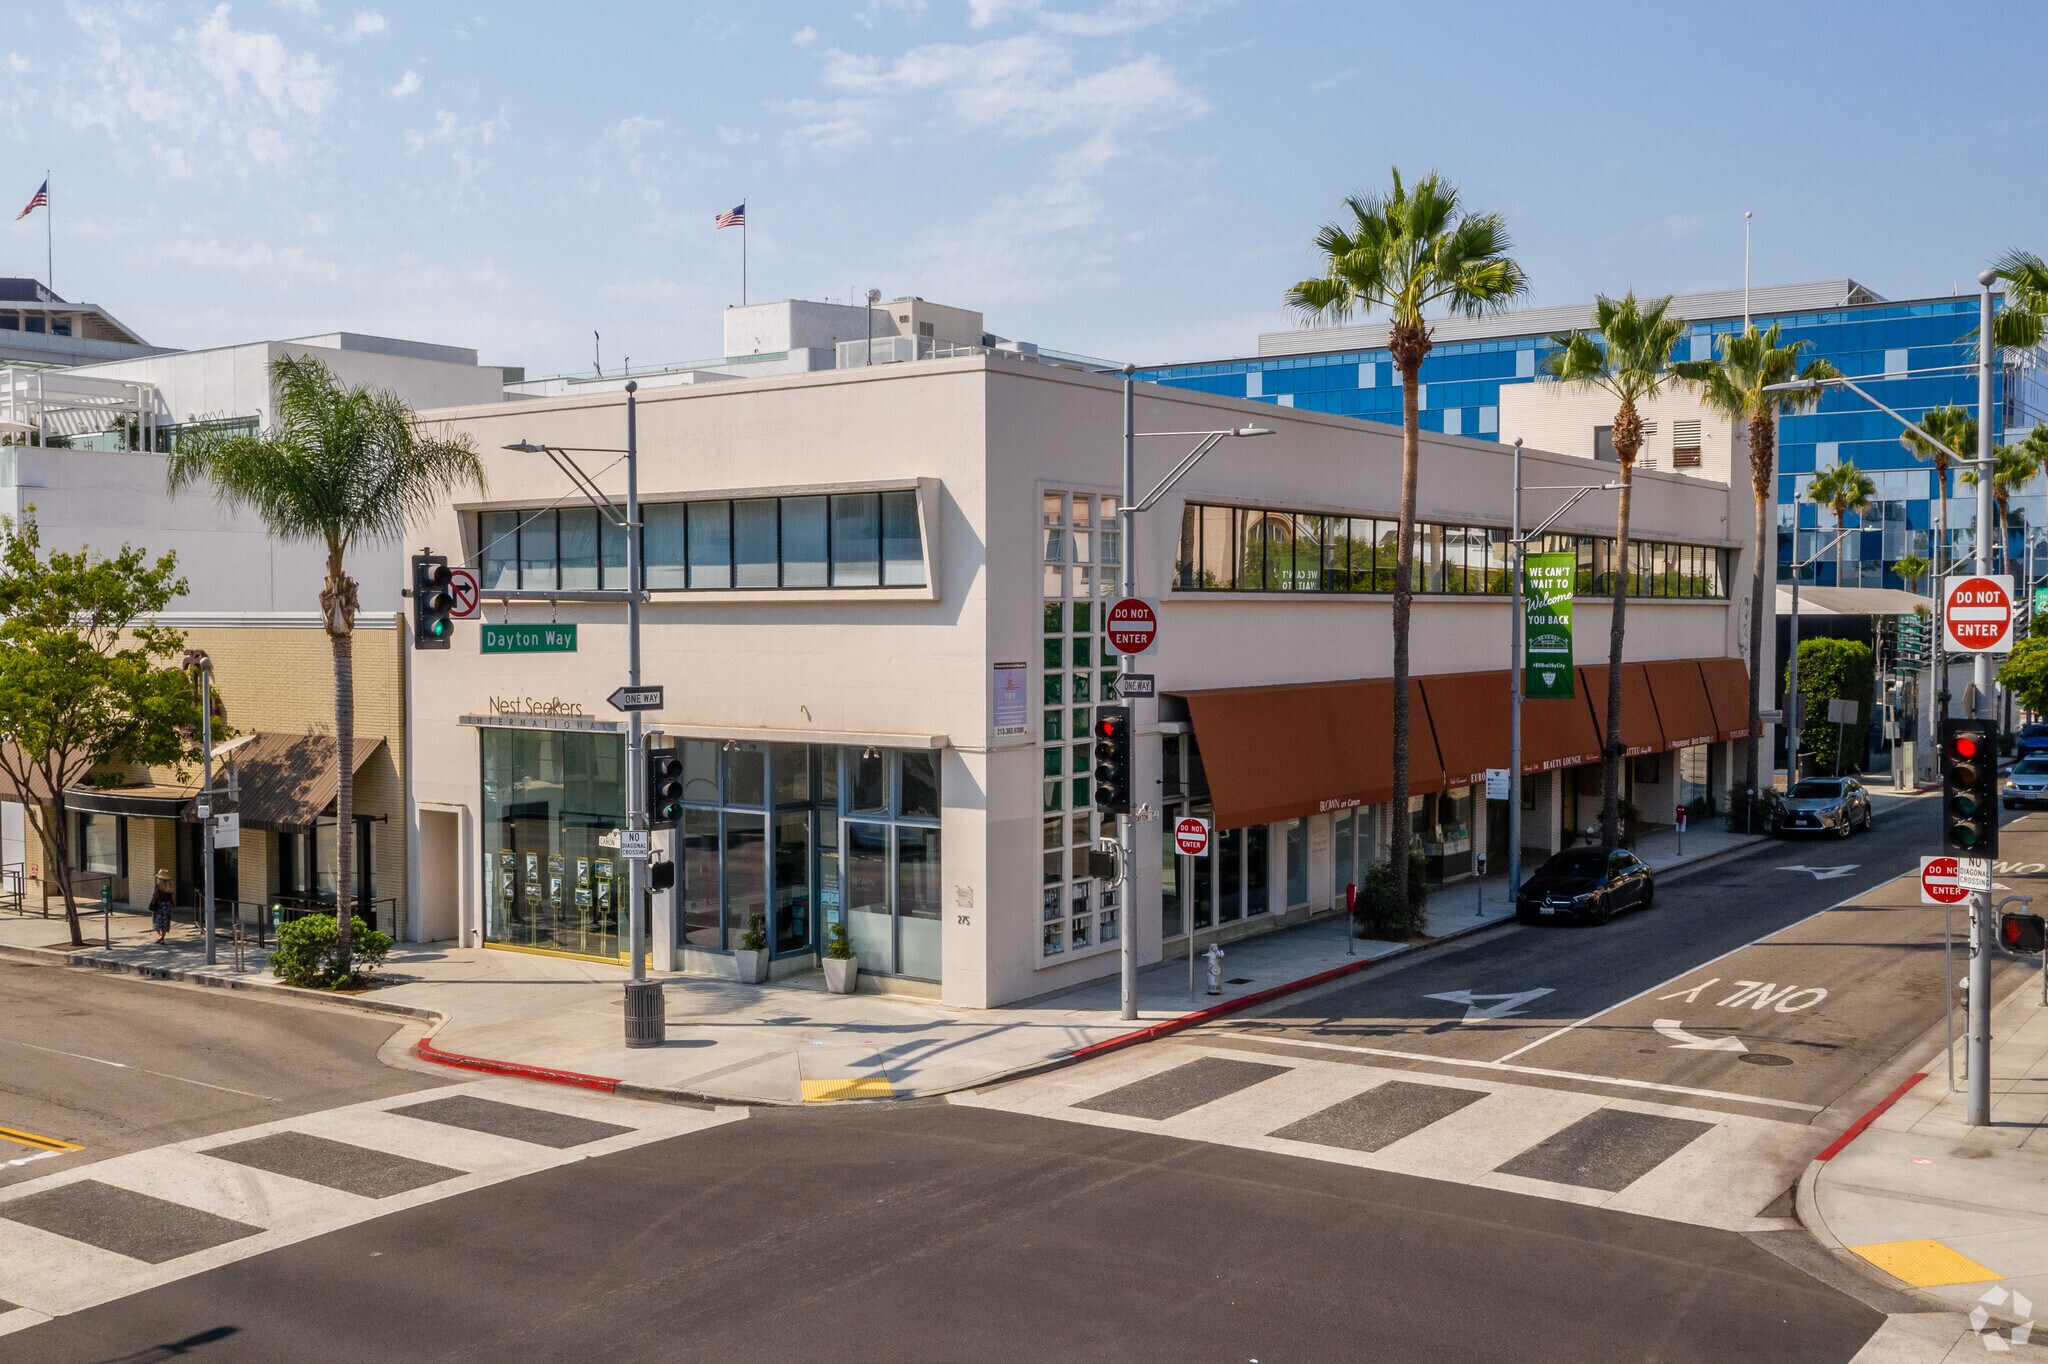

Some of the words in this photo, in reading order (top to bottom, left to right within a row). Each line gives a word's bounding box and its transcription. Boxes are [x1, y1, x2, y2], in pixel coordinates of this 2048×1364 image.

[1529, 567, 1542, 577] WE
[1544, 566, 1571, 577] CAN'T
[1530, 579, 1553, 589] WAIT
[1556, 579, 1569, 589] TO
[1526, 591, 1574, 613] Welcome
[1956, 591, 1973, 604] DO
[1976, 591, 2001, 604] NOT
[1115, 608, 1128, 619] DO
[1130, 608, 1149, 619] NOT
[1528, 615, 1545, 625] YOU
[1548, 615, 1569, 625] BACK
[1957, 624, 1998, 637] ENTER
[486, 630, 539, 650] Dayton
[545, 630, 572, 649] Way
[1116, 633, 1148, 644] ENTER
[1124, 681, 1136, 691] ONE
[1136, 681, 1150, 691] WAY
[625, 694, 642, 704] ONE
[643, 693, 659, 703] WAY
[489, 696, 522, 715] Nest
[525, 696, 582, 717] Seekers
[468, 716, 609, 731] INTERNATIONAL
[1543, 758, 1562, 770] BEAUTY
[1562, 755, 1581, 767] LOUNGE
[1180, 824, 1189, 832] DO
[1191, 825, 1203, 833] NOT
[599, 837, 616, 847] CANON
[629, 832, 640, 842] NO
[1182, 840, 1201, 849] ENTER
[1968, 857, 1982, 868] NO
[1929, 866, 1942, 875] DO
[1946, 867, 1958, 875] NO
[1959, 867, 1990, 879] DIAGONAL
[1959, 877, 1990, 888] CROSSING
[1932, 886, 1962, 896] ENTER
[957, 915, 971, 926] 275
[1656, 977, 1828, 1014] ONLY
